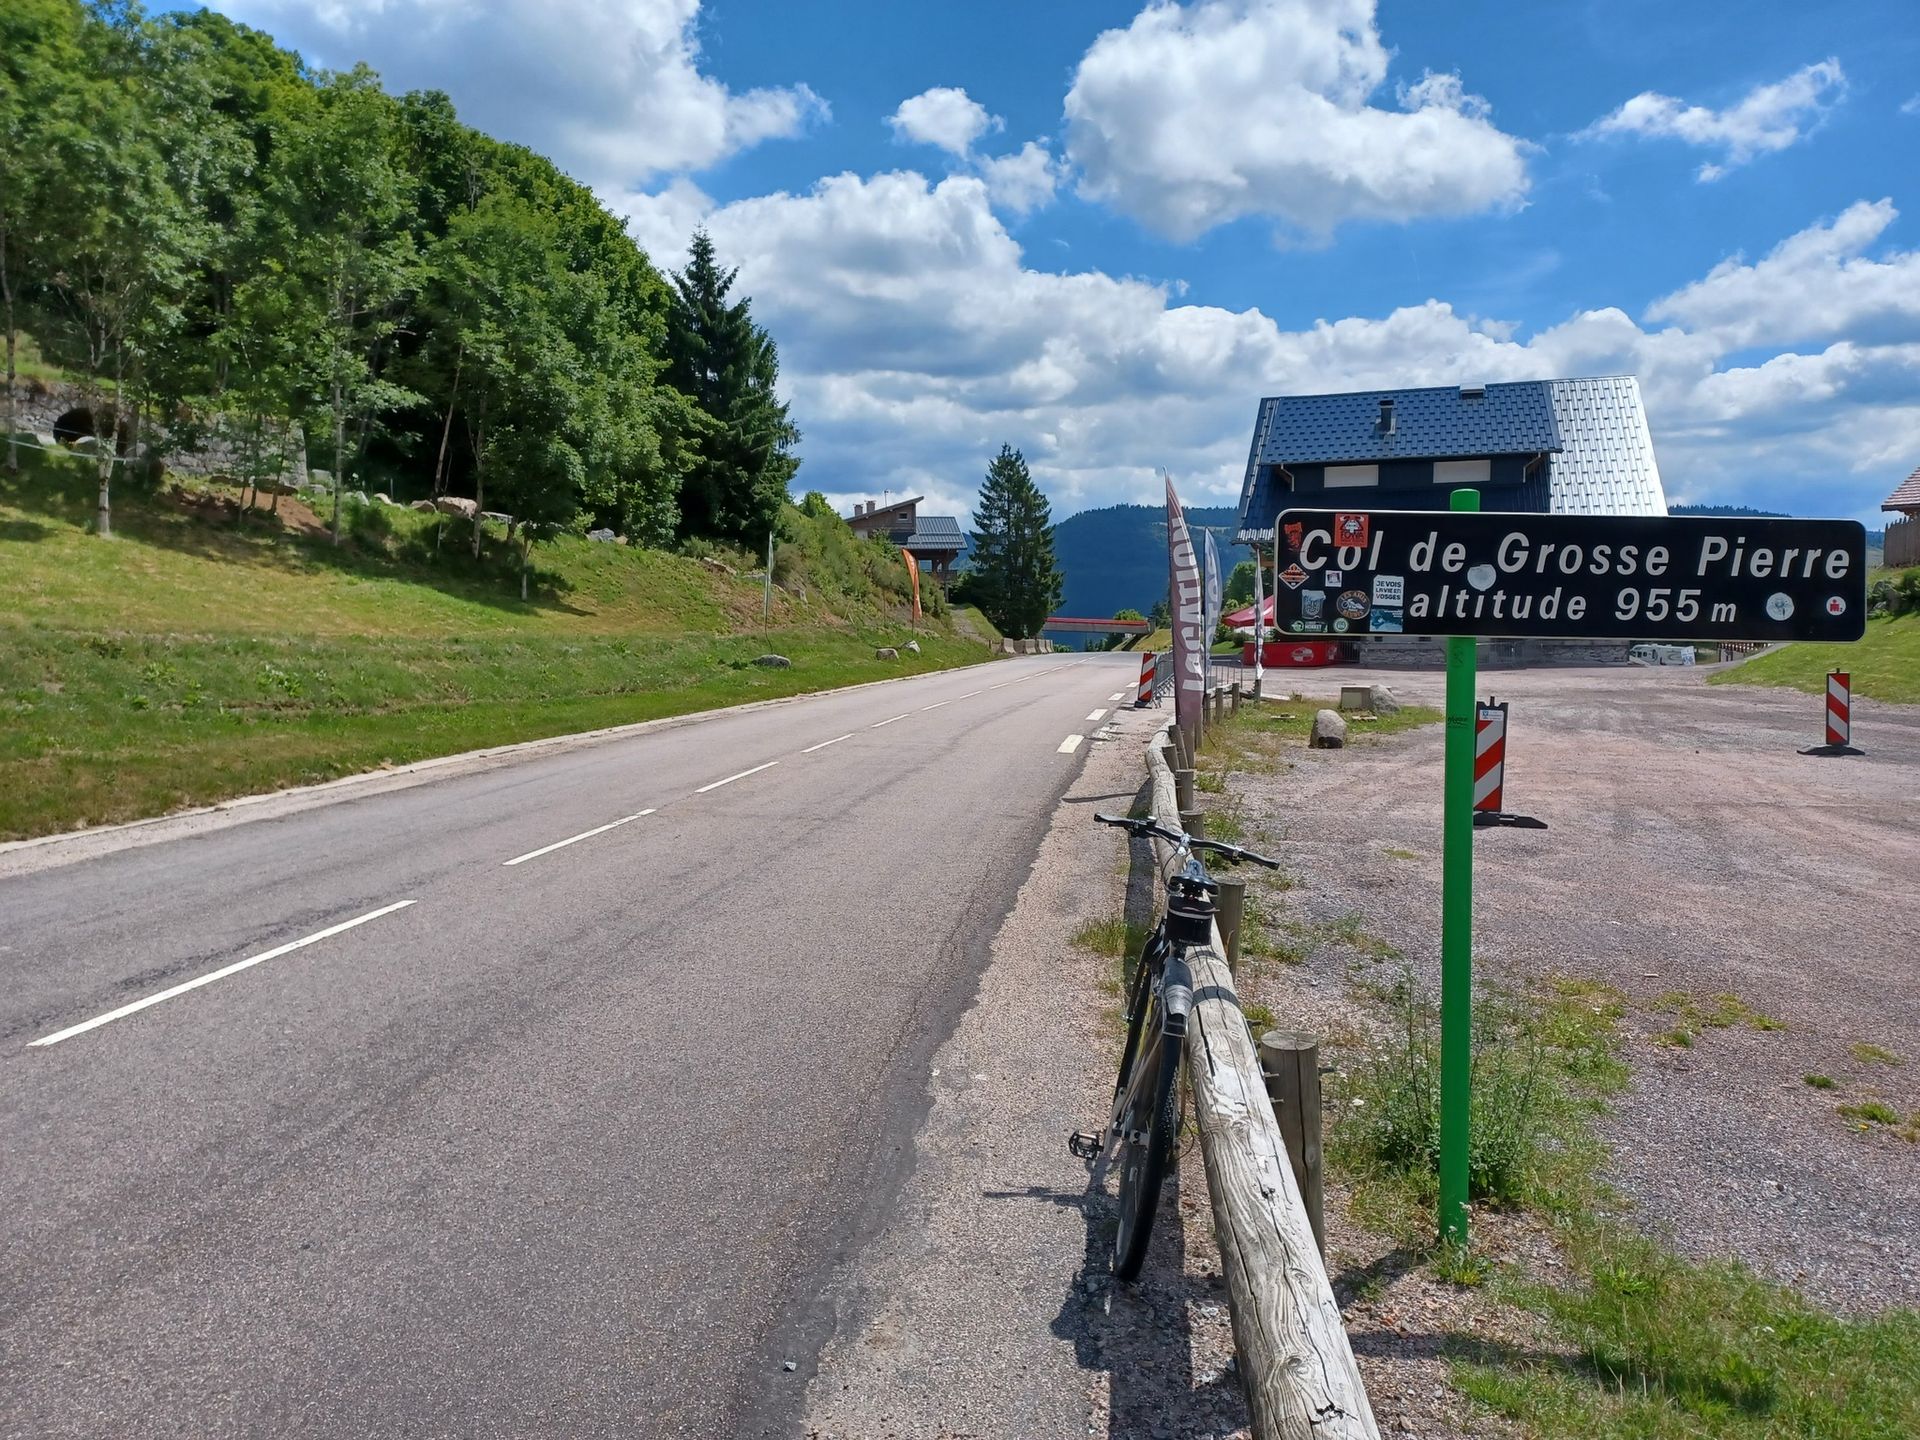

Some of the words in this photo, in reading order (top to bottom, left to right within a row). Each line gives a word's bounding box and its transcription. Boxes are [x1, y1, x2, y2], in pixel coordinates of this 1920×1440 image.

[1300, 529, 1384, 571] Col
[1409, 531, 1466, 573] de
[1497, 532, 1670, 576] Grosse
[1697, 536, 1850, 579] Pierre
[1409, 585, 1586, 620] altitude
[1615, 588, 1701, 622] 955
[1711, 603, 1737, 623] m
